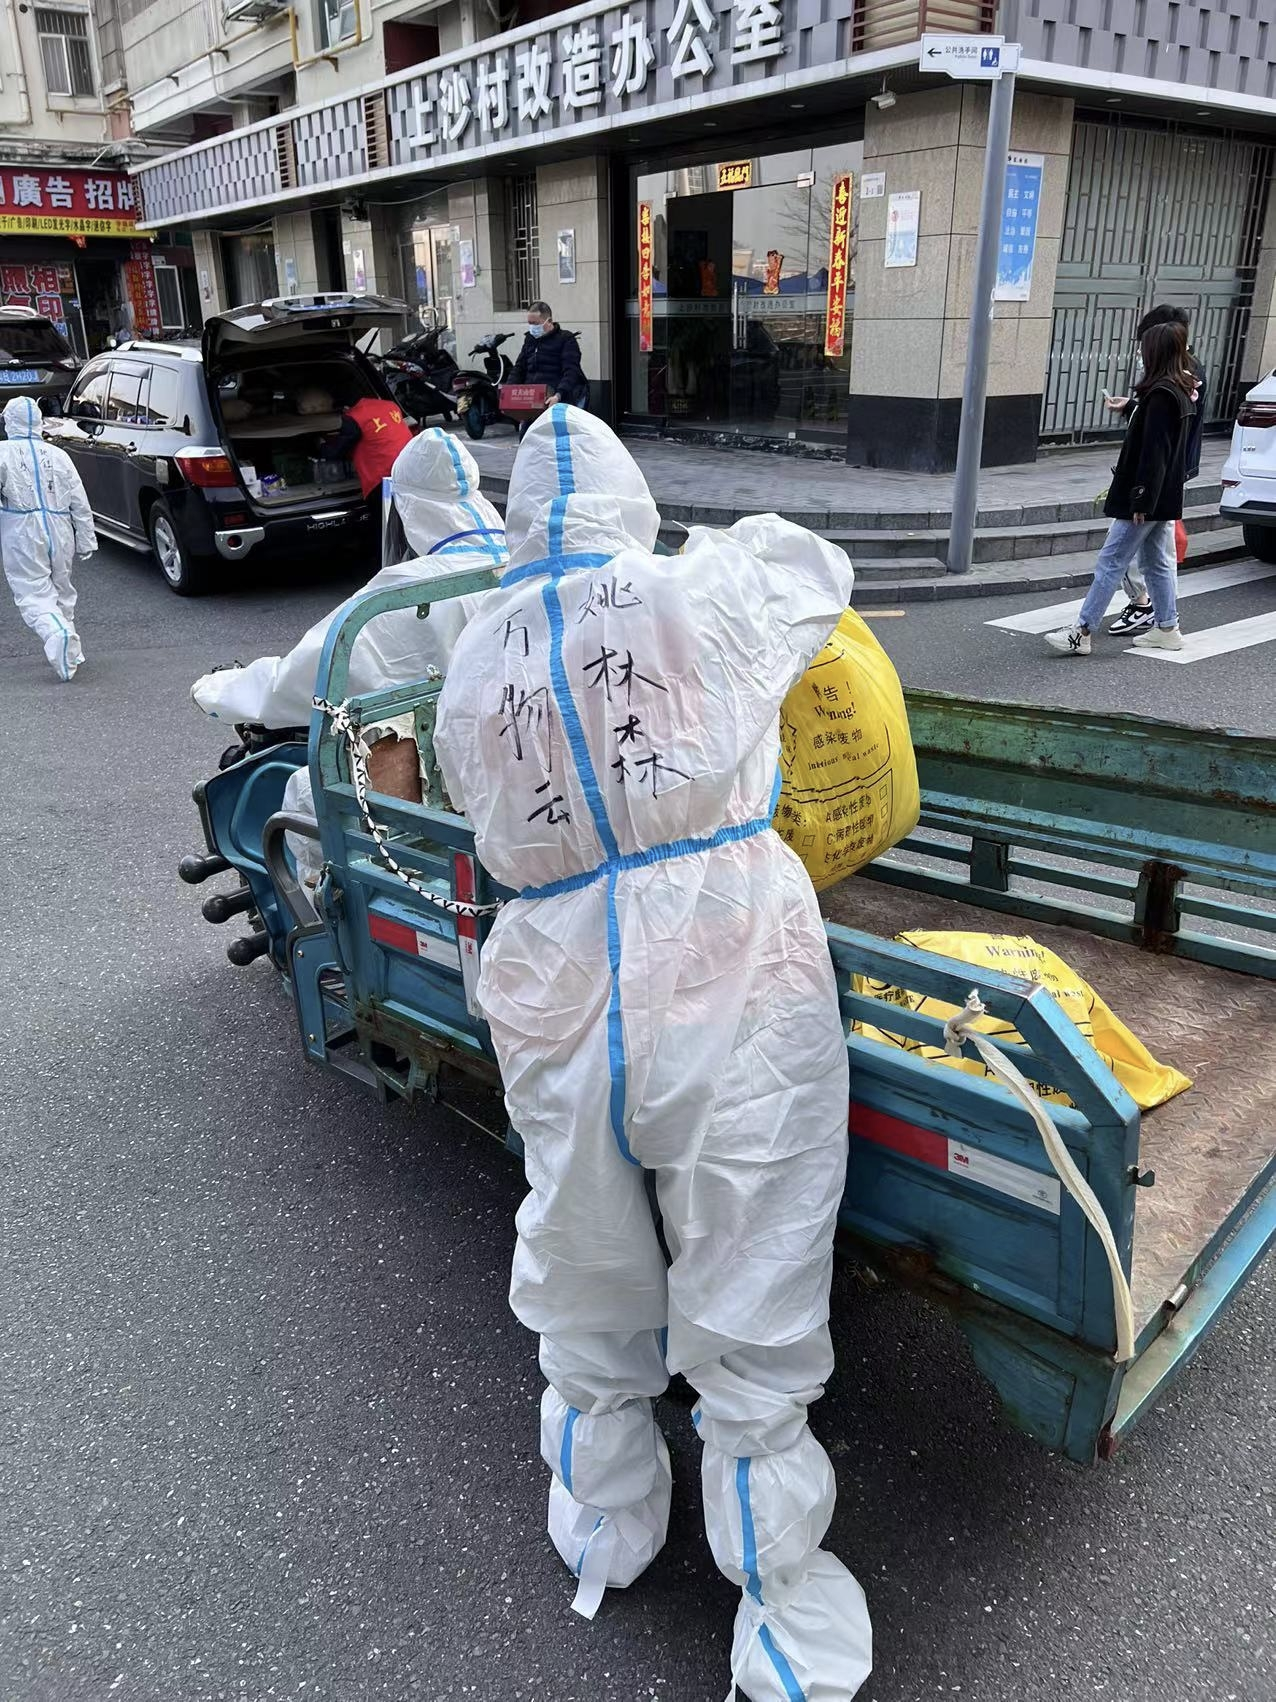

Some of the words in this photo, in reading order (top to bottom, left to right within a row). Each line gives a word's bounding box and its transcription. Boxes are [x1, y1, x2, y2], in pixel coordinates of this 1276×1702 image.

[409, 0, 790, 148] 上沙村改造办公室
